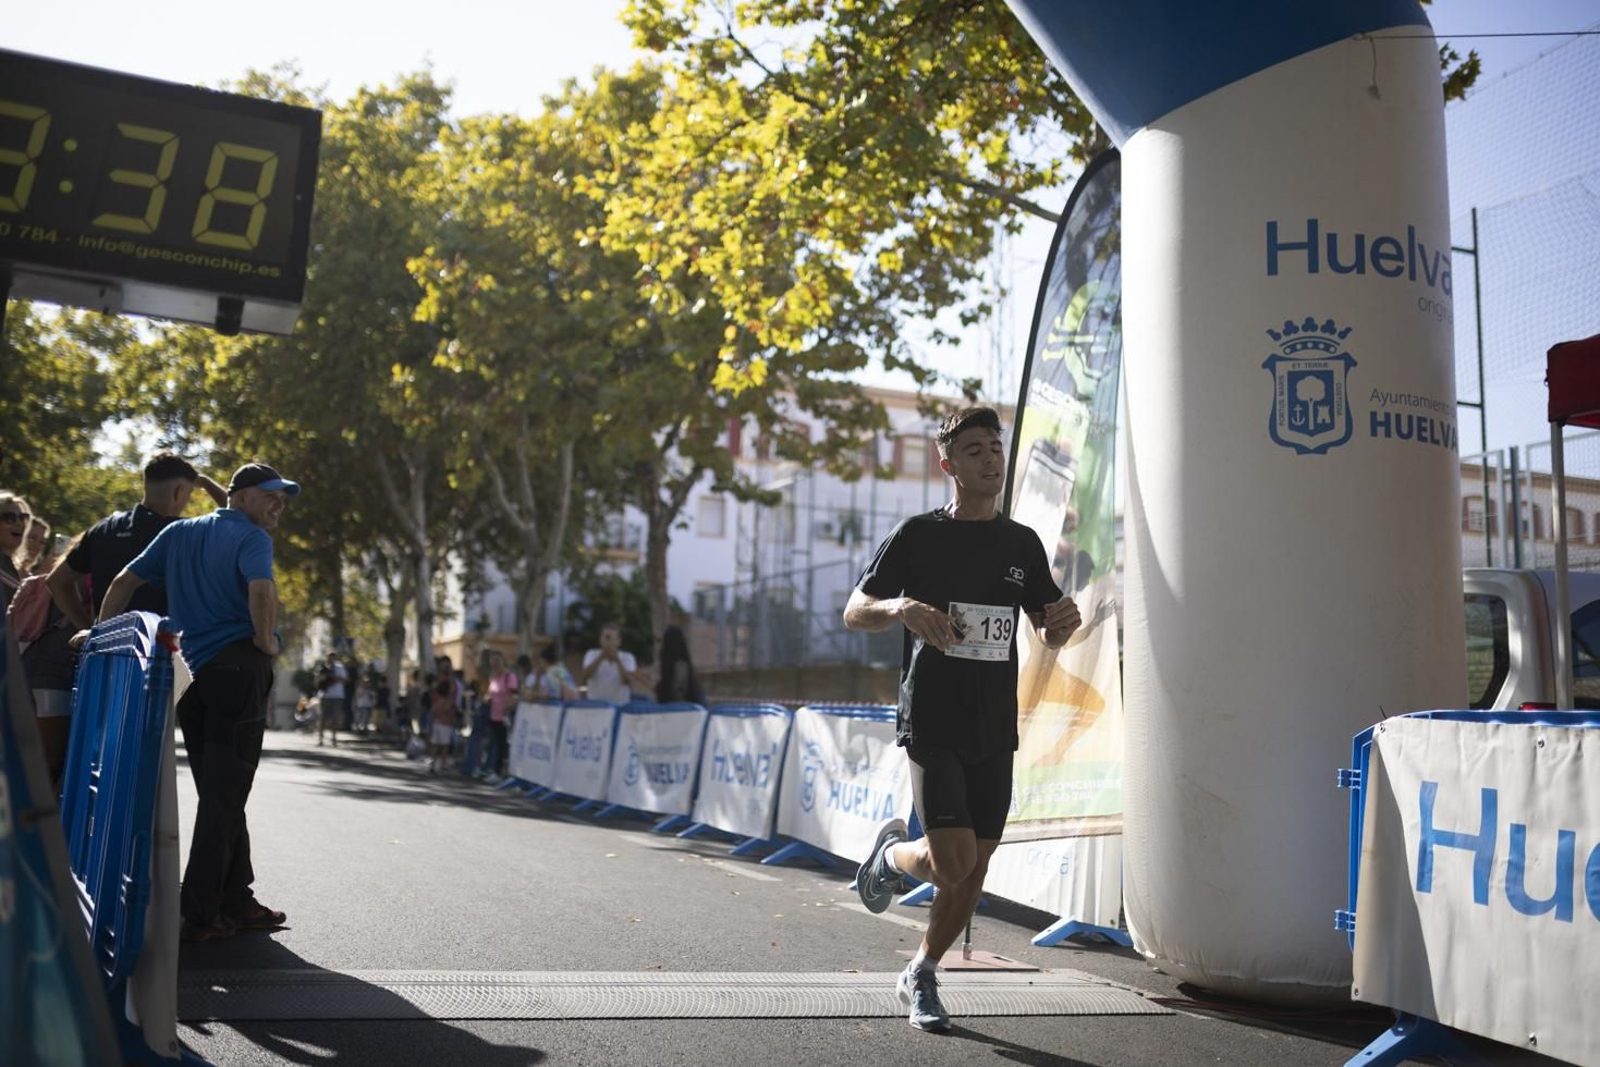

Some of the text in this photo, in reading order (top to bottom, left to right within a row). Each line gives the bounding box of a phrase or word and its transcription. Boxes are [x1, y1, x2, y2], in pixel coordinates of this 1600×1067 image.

[78, 234, 281, 278] info@gesconchip.es
[981, 616, 1012, 641] 139
[827, 779, 897, 821] HUELVA
[1416, 780, 1600, 924] Hu
